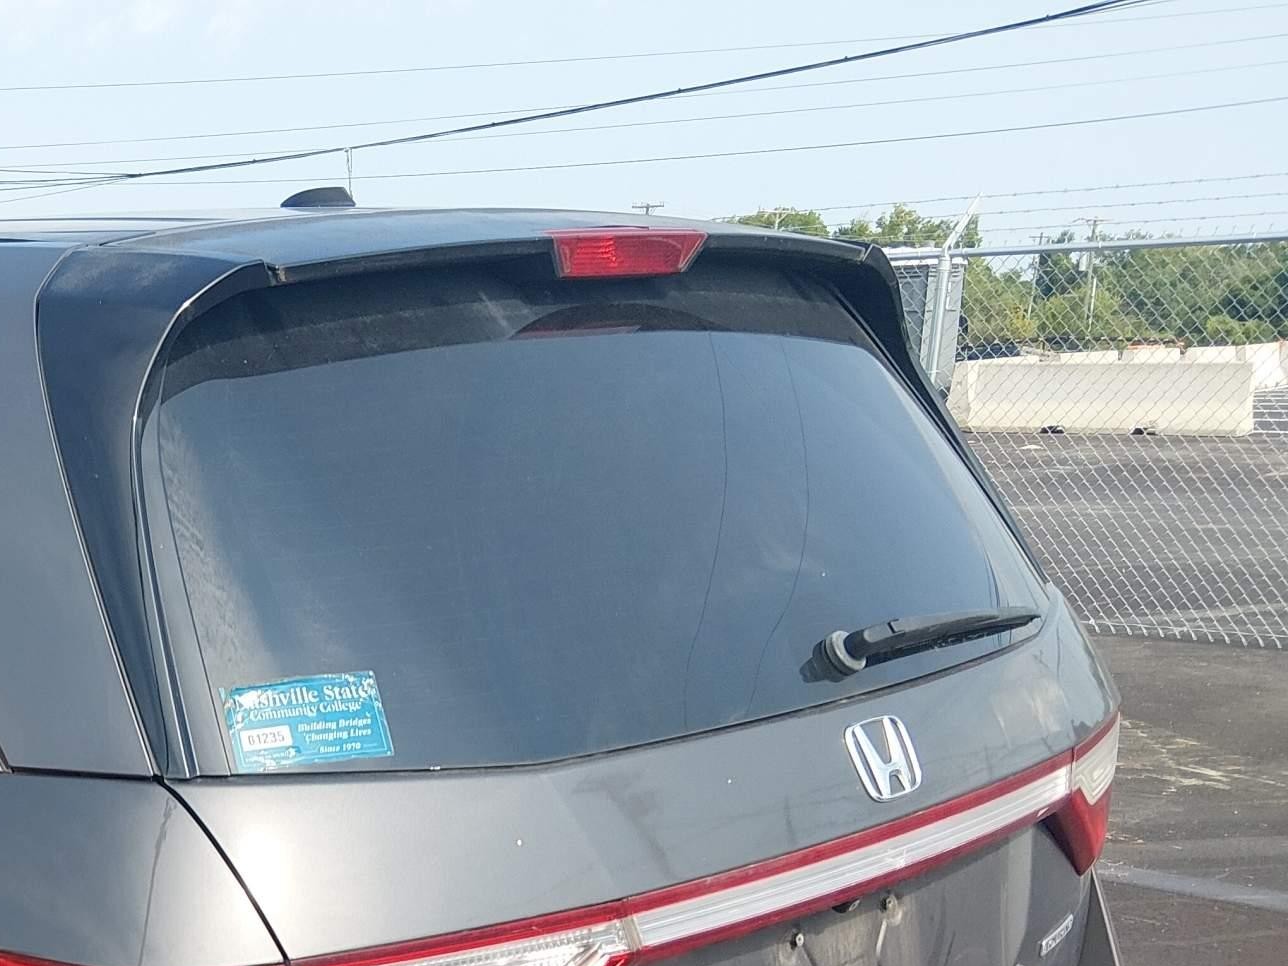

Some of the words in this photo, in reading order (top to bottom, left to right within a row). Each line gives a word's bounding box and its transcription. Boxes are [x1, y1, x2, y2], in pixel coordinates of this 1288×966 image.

[249, 703, 318, 721] Community
[319, 700, 361, 713] College
[339, 717, 371, 729] Bridges
